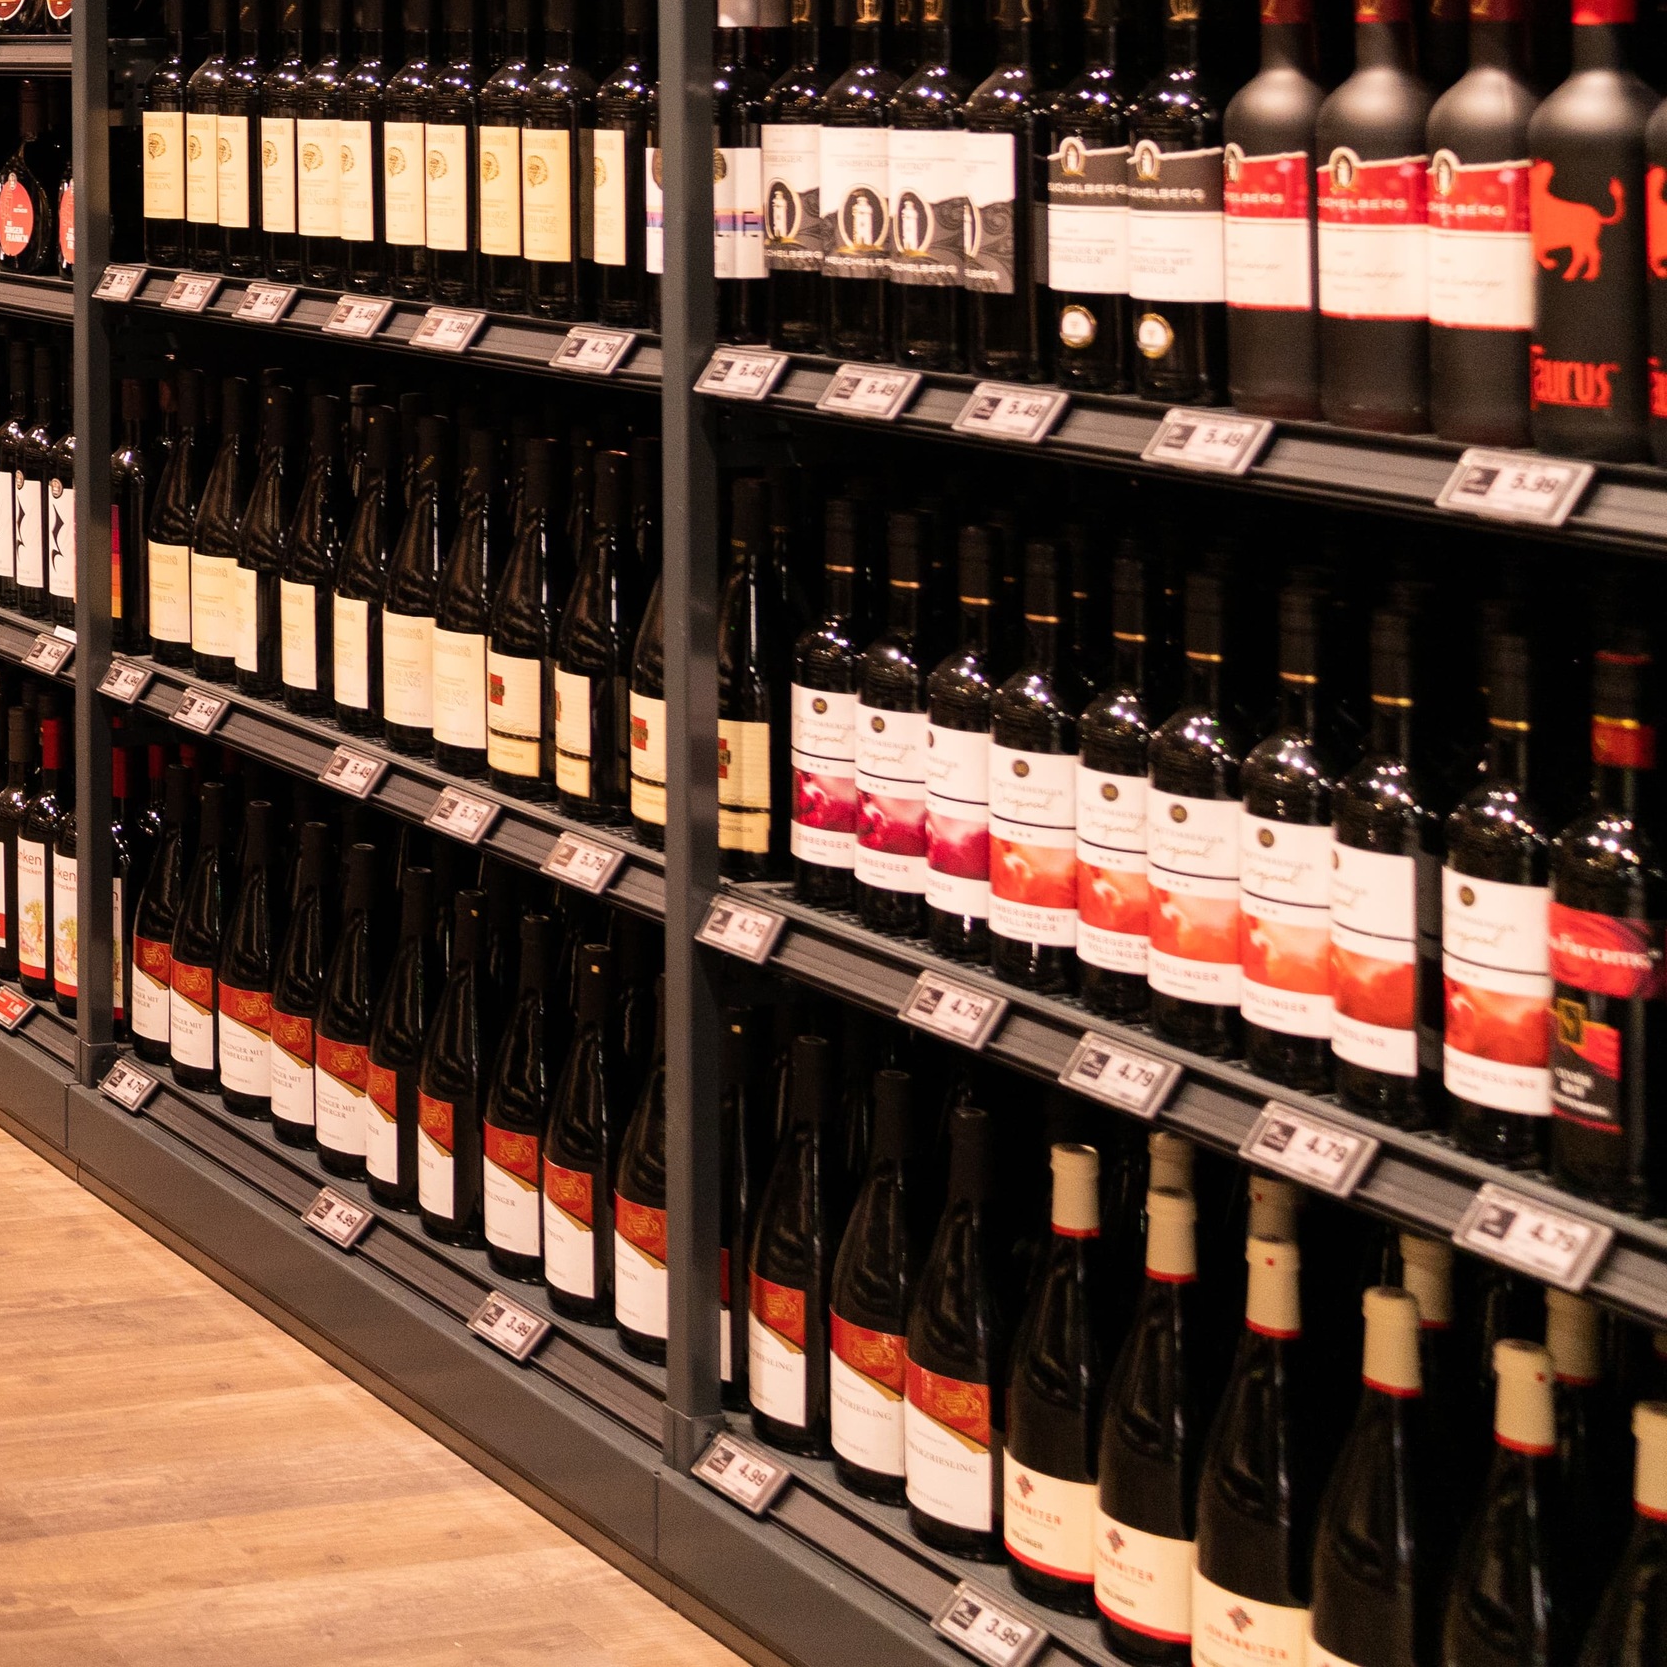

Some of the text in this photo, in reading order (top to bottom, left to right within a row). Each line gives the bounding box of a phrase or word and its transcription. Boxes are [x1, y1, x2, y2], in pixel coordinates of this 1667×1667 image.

[738, 917, 767, 938] 4.79
[951, 995, 984, 1021] 4.79
[1117, 1060, 1154, 1088] 4.79
[1306, 1135, 1349, 1164] 4.79
[335, 1209, 359, 1229] 4.99
[506, 1316, 532, 1338] 3.99
[738, 1462, 768, 1486] 4.99
[985, 1616, 1023, 1648] 3.99
